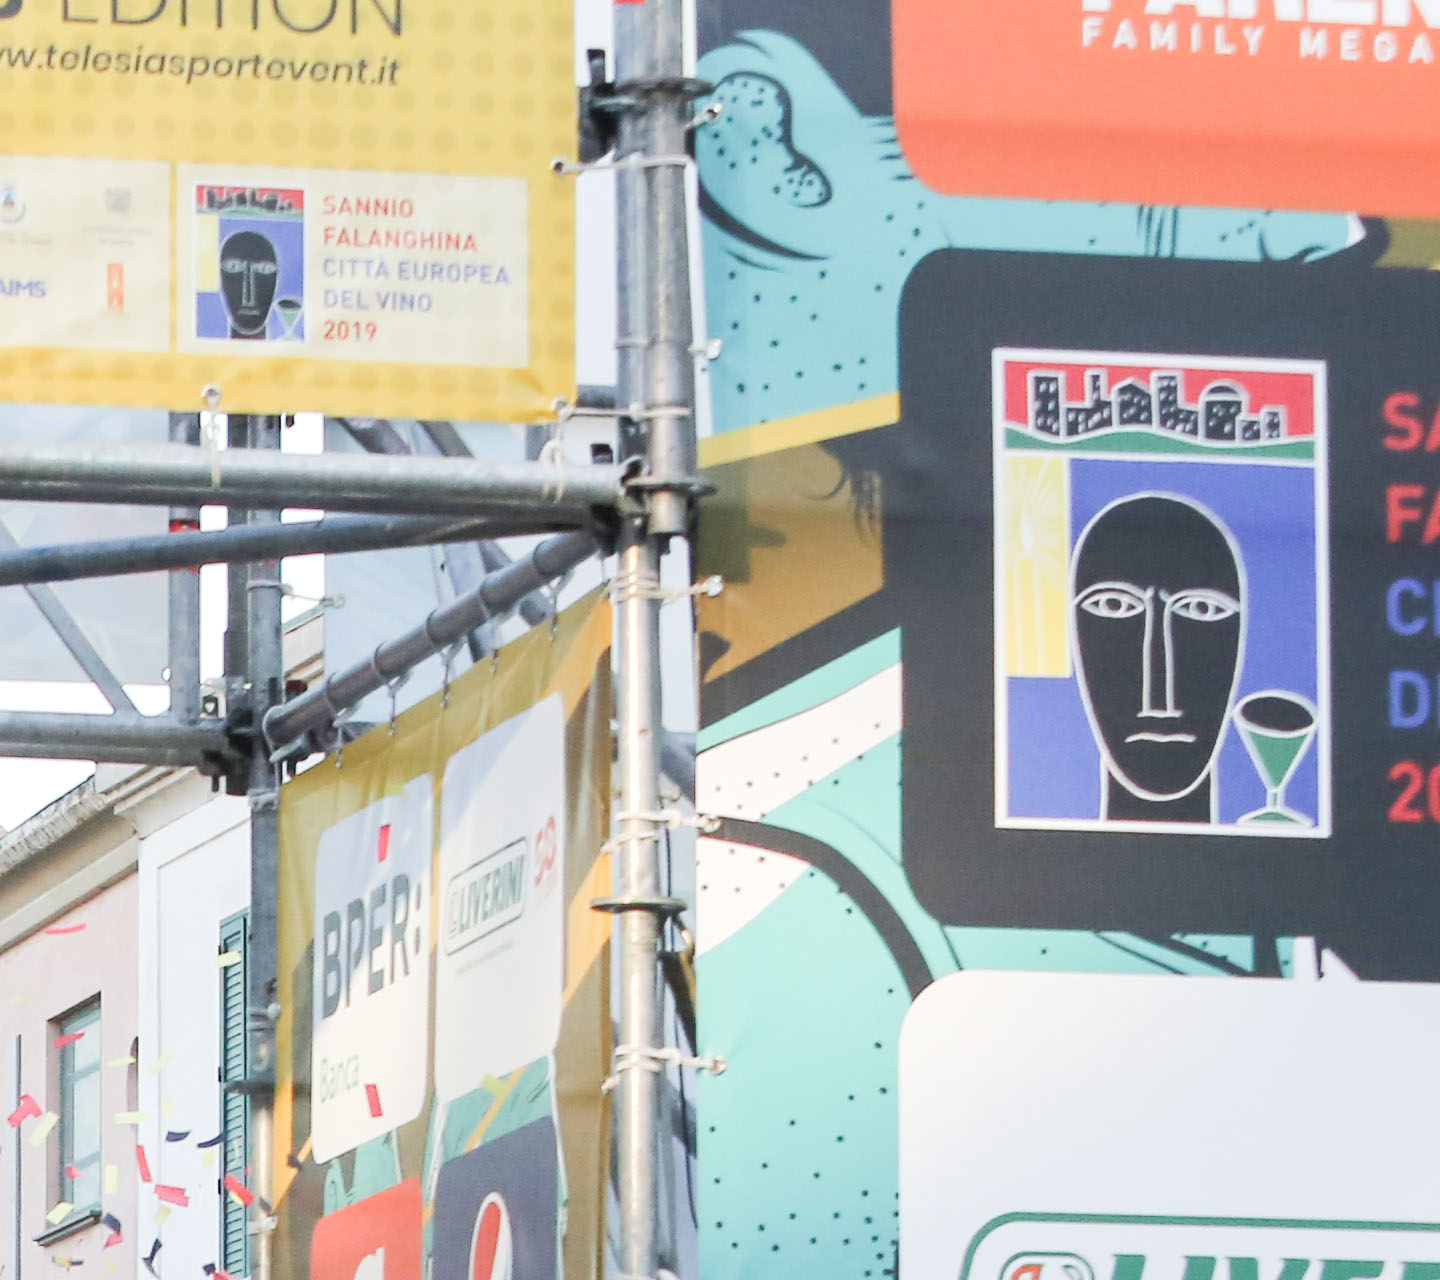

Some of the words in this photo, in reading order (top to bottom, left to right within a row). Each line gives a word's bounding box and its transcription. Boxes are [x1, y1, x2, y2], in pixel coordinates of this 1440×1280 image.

[1081, 17, 1265, 55] FAMILY
[1299, 29, 1436, 65] MEGA
[323, 195, 414, 219] SANNIO
[323, 226, 478, 252] FALANGHINA
[398, 259, 509, 285] EUROPEA
[323, 289, 369, 310] DEL
[377, 290, 433, 313] VINO
[323, 319, 378, 341] 2019
[458, 854, 526, 934] LIVERINI
[321, 873, 423, 1019] BPER:
